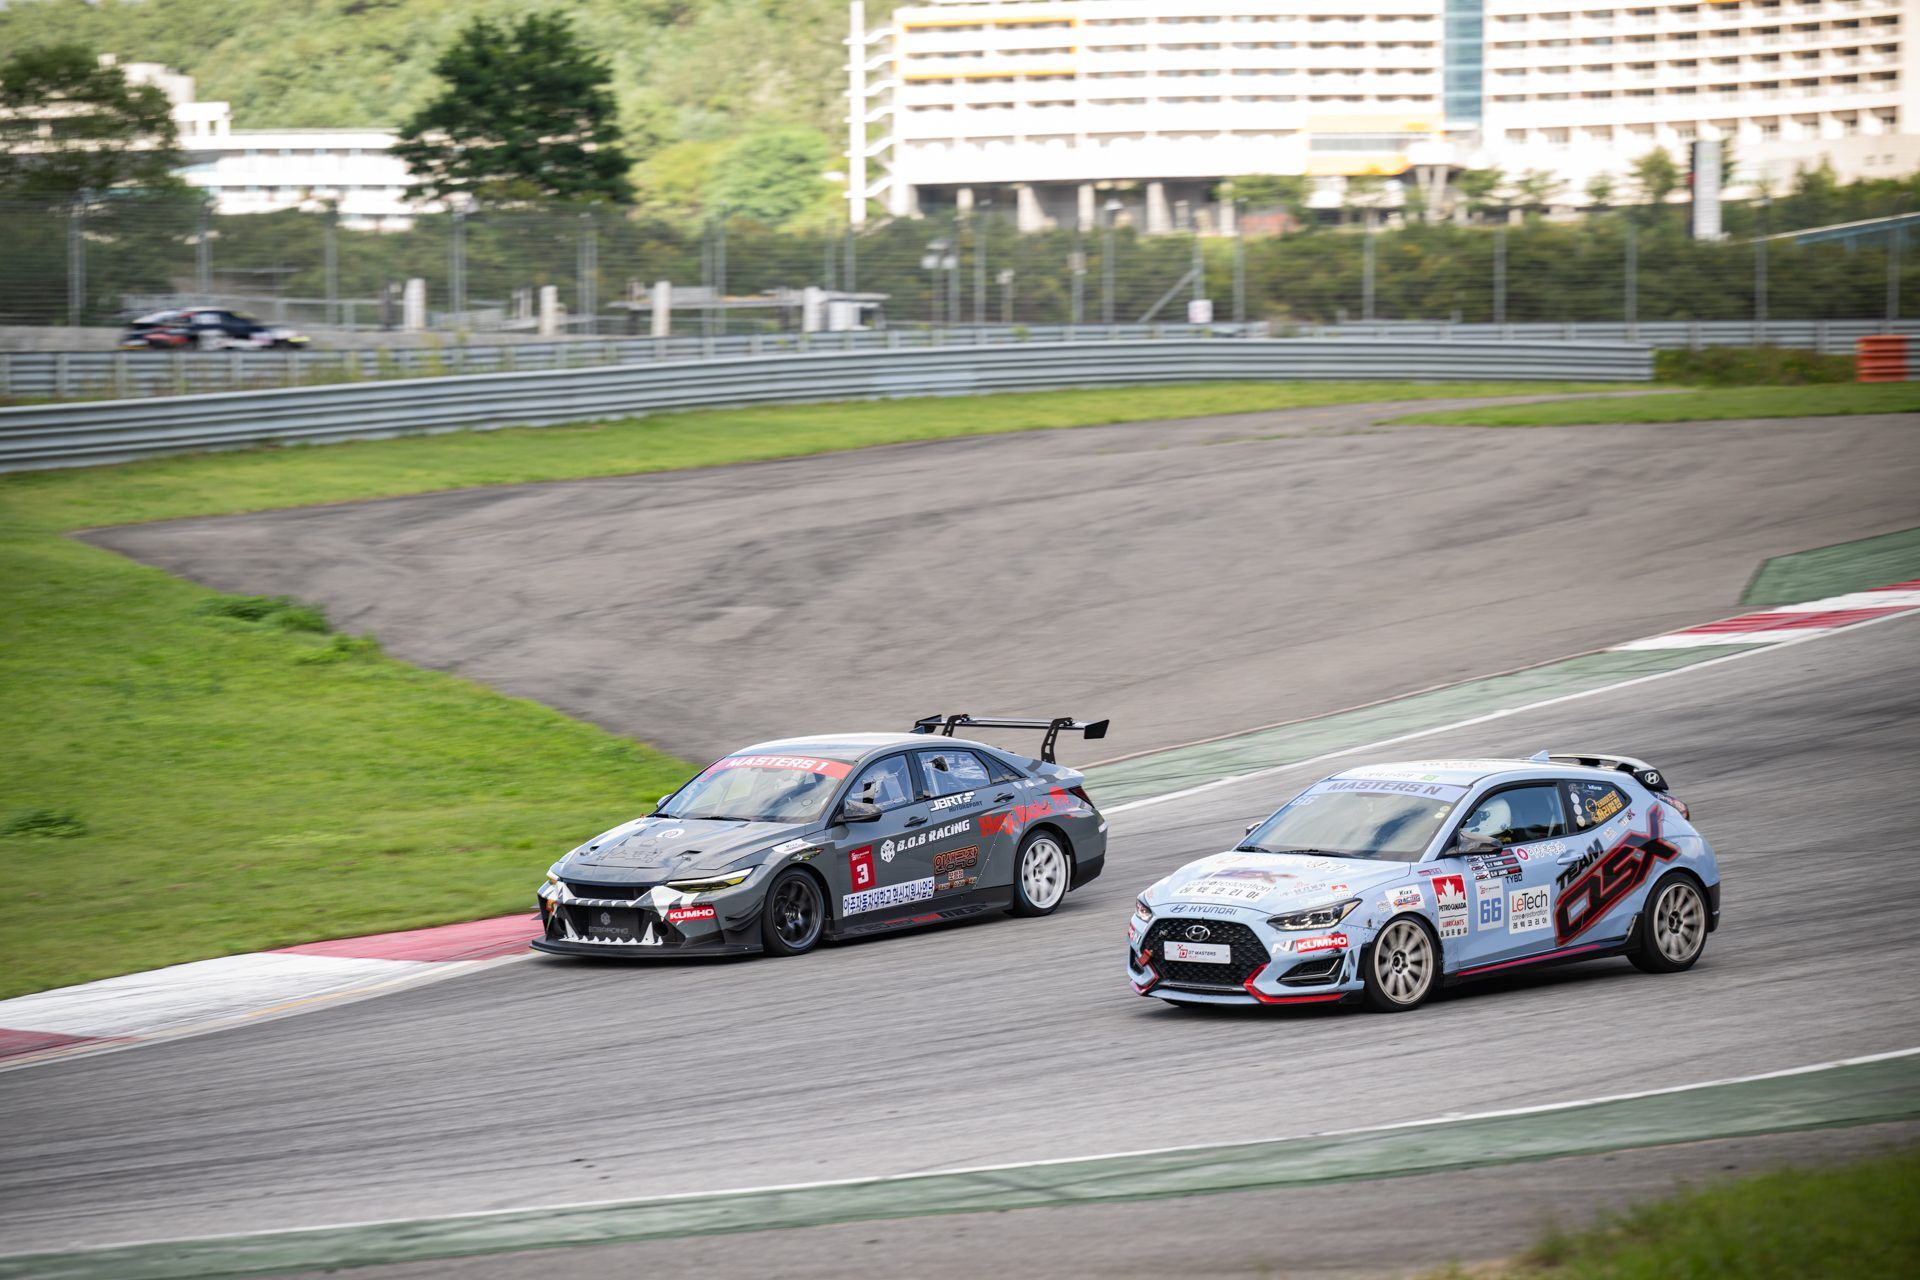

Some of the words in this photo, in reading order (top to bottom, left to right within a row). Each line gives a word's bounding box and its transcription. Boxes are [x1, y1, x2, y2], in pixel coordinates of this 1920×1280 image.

[725, 756, 816, 769] MASTERS
[1327, 780, 1421, 793] MASTERS
[1422, 786, 1442, 795] N
[896, 834, 926, 852] B.O.B
[928, 819, 970, 842] RACING
[856, 863, 869, 884] 3
[1556, 838, 1604, 892] TEAM
[1188, 905, 1238, 915] HYUNDAI
[1480, 897, 1502, 924] 66
[1511, 890, 1548, 913] LeTech
[669, 908, 715, 919] KUMHO
[1297, 936, 1347, 951] KUMHO
